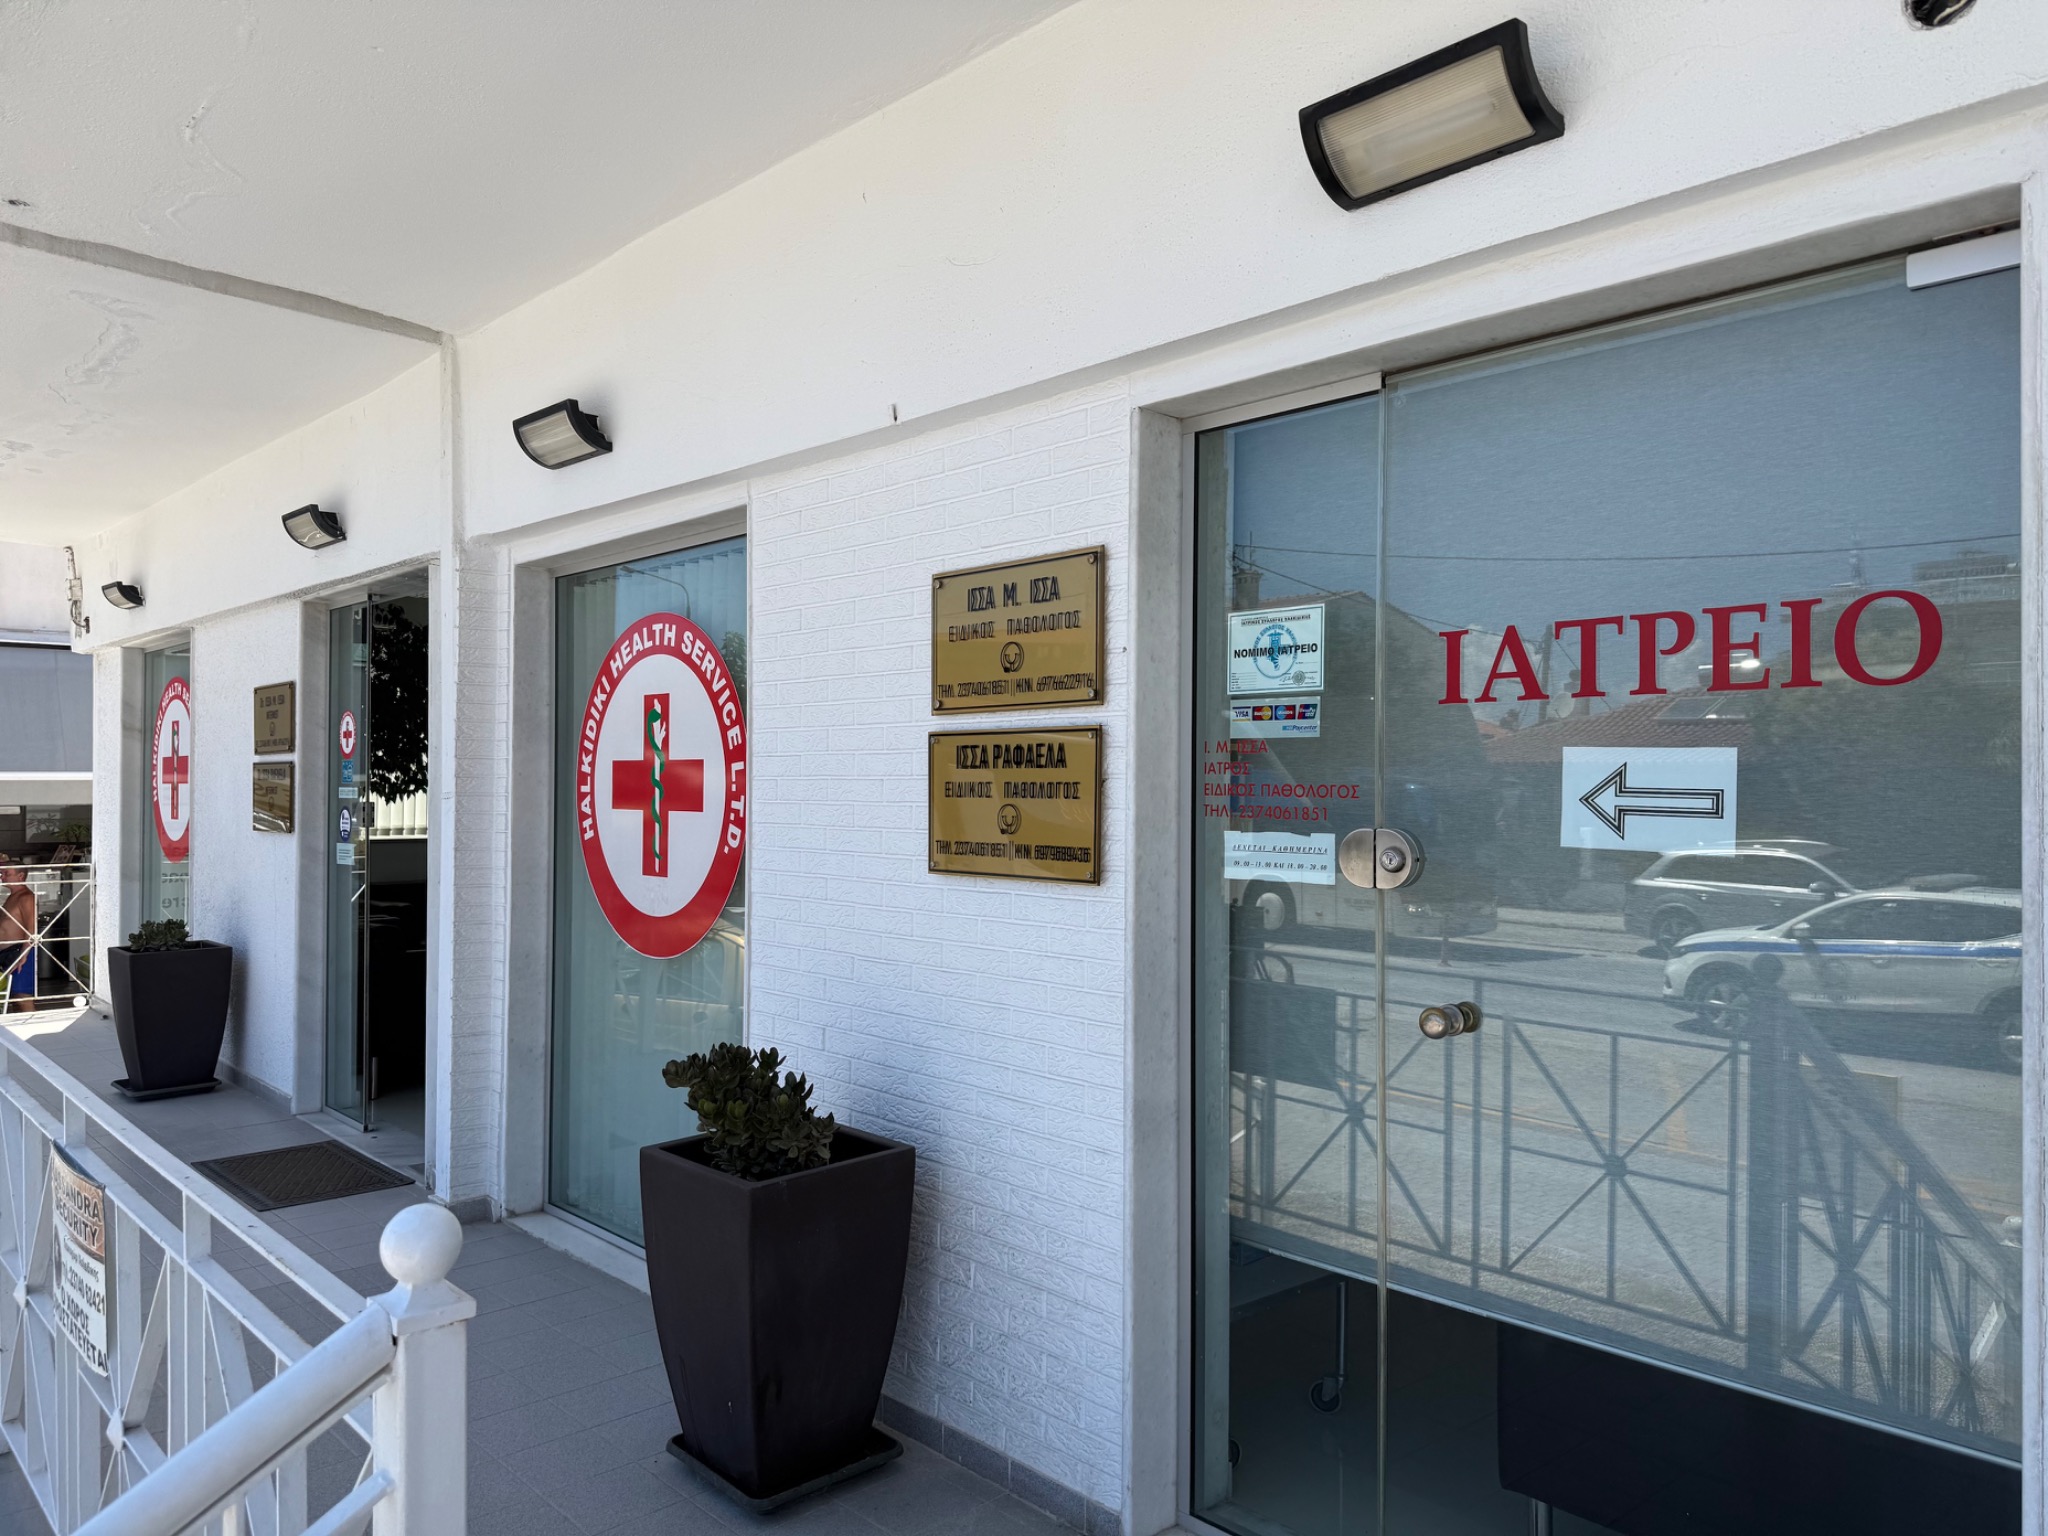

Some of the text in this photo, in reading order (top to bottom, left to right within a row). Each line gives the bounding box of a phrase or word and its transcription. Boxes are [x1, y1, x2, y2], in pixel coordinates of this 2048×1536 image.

[967, 585, 996, 612] ΙΣΣΑ
[1030, 576, 1060, 604] ΙΣΣΑ
[948, 610, 1081, 642] ΕΙΔΙΚΟΣ ΠΑΘΟΛΟΓΟΣ
[1234, 647, 1274, 659] ΝΟΜΙΜΟ
[1278, 643, 1318, 656] ΙΑΤΡΕΙΟ
[1438, 590, 1943, 704] ΙΑΤΡΕΙΟ
[162, 683, 182, 710] HEALTH
[580, 675, 611, 841] HALKIDIKI
[609, 623, 677, 676] HEALTH
[681, 630, 742, 750] SERVICE
[956, 742, 1067, 769] ΙΣΣΑ ΡΑΦΑΕΛΑ
[1237, 739, 1268, 754] ΙΣΣΑ
[1204, 762, 1251, 776] ΙΑΤΡΟΣ
[944, 781, 1081, 800] ΕΙΔΙΚΟΣ ΠΑΘΟΛΟΓΟΣ
[1204, 783, 1360, 799] ΕΙΔΙΚΟΣ ΠΑΘΟΛΟΓΟΣ
[1239, 805, 1328, 821] 2374061851
